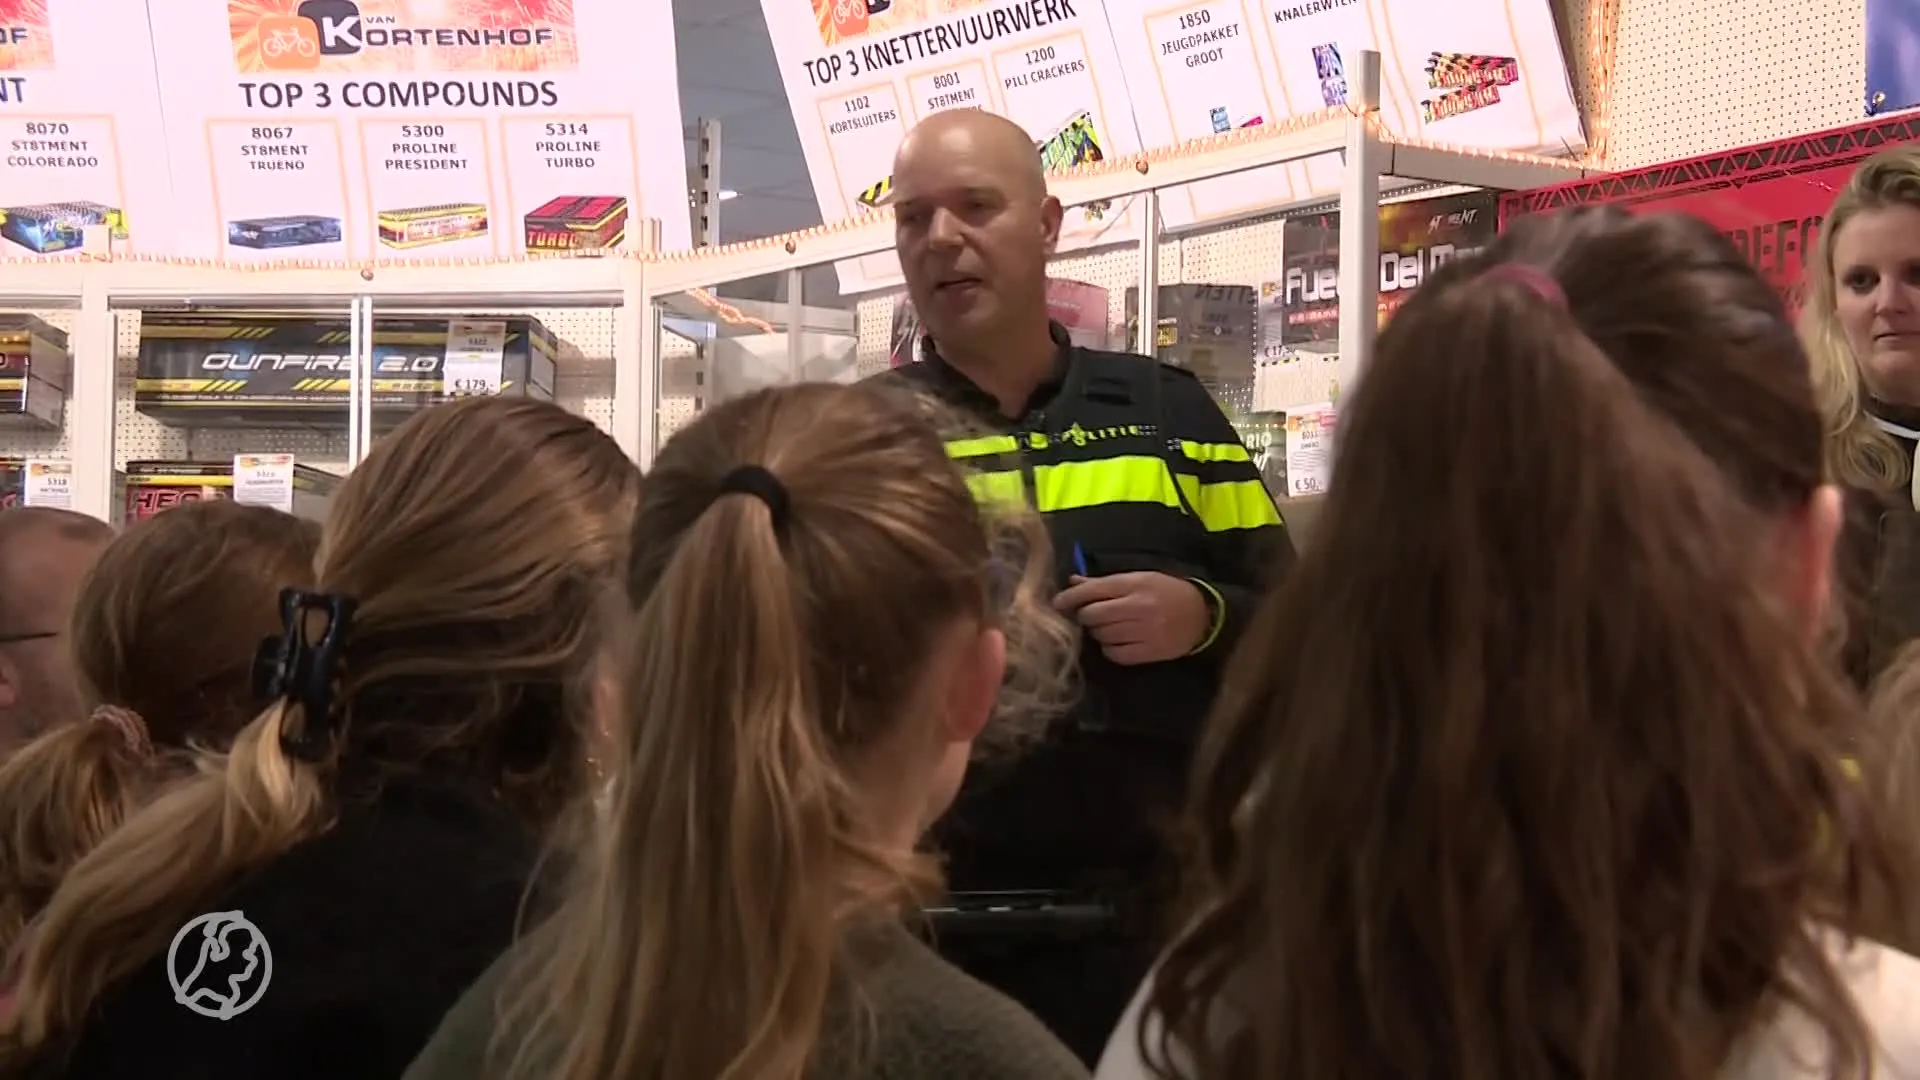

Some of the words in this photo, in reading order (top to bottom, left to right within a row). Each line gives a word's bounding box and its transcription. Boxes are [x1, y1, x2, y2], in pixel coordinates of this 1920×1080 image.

[1179, 10, 1212, 32] 1850
[803, 54, 841, 86] TOP
[846, 50, 859, 77] 3
[862, 0, 1076, 71] KNETTERVUURWERK
[1162, 22, 1238, 56] JEUGDPAKKET
[1025, 46, 1055, 67] 1200
[1185, 47, 1224, 67] GROOT
[1030, 59, 1085, 83] CRACKERS
[934, 72, 960, 89] 8001
[238, 83, 303, 108] TOP
[314, 82, 331, 108] 3
[342, 81, 558, 108] COMPOUNDS
[845, 96, 870, 113] 1102
[26, 122, 69, 135] 8070
[402, 125, 444, 137] 5300
[546, 123, 588, 136] 5314
[829, 110, 896, 135] KORTSLUITERS
[252, 127, 292, 139] 8067
[393, 144, 456, 153] PROLINE
[536, 141, 600, 151] PROLINE
[8, 156, 98, 167] COLOREADO
[250, 160, 304, 170] TRUENO
[385, 159, 467, 170] PRESIDENT
[546, 158, 595, 168] TURBO
[1286, 266, 1340, 304] Fue
[202, 353, 353, 371] GUNFIRE
[378, 356, 439, 371] 2.0
[1240, 431, 1272, 449] RIO
